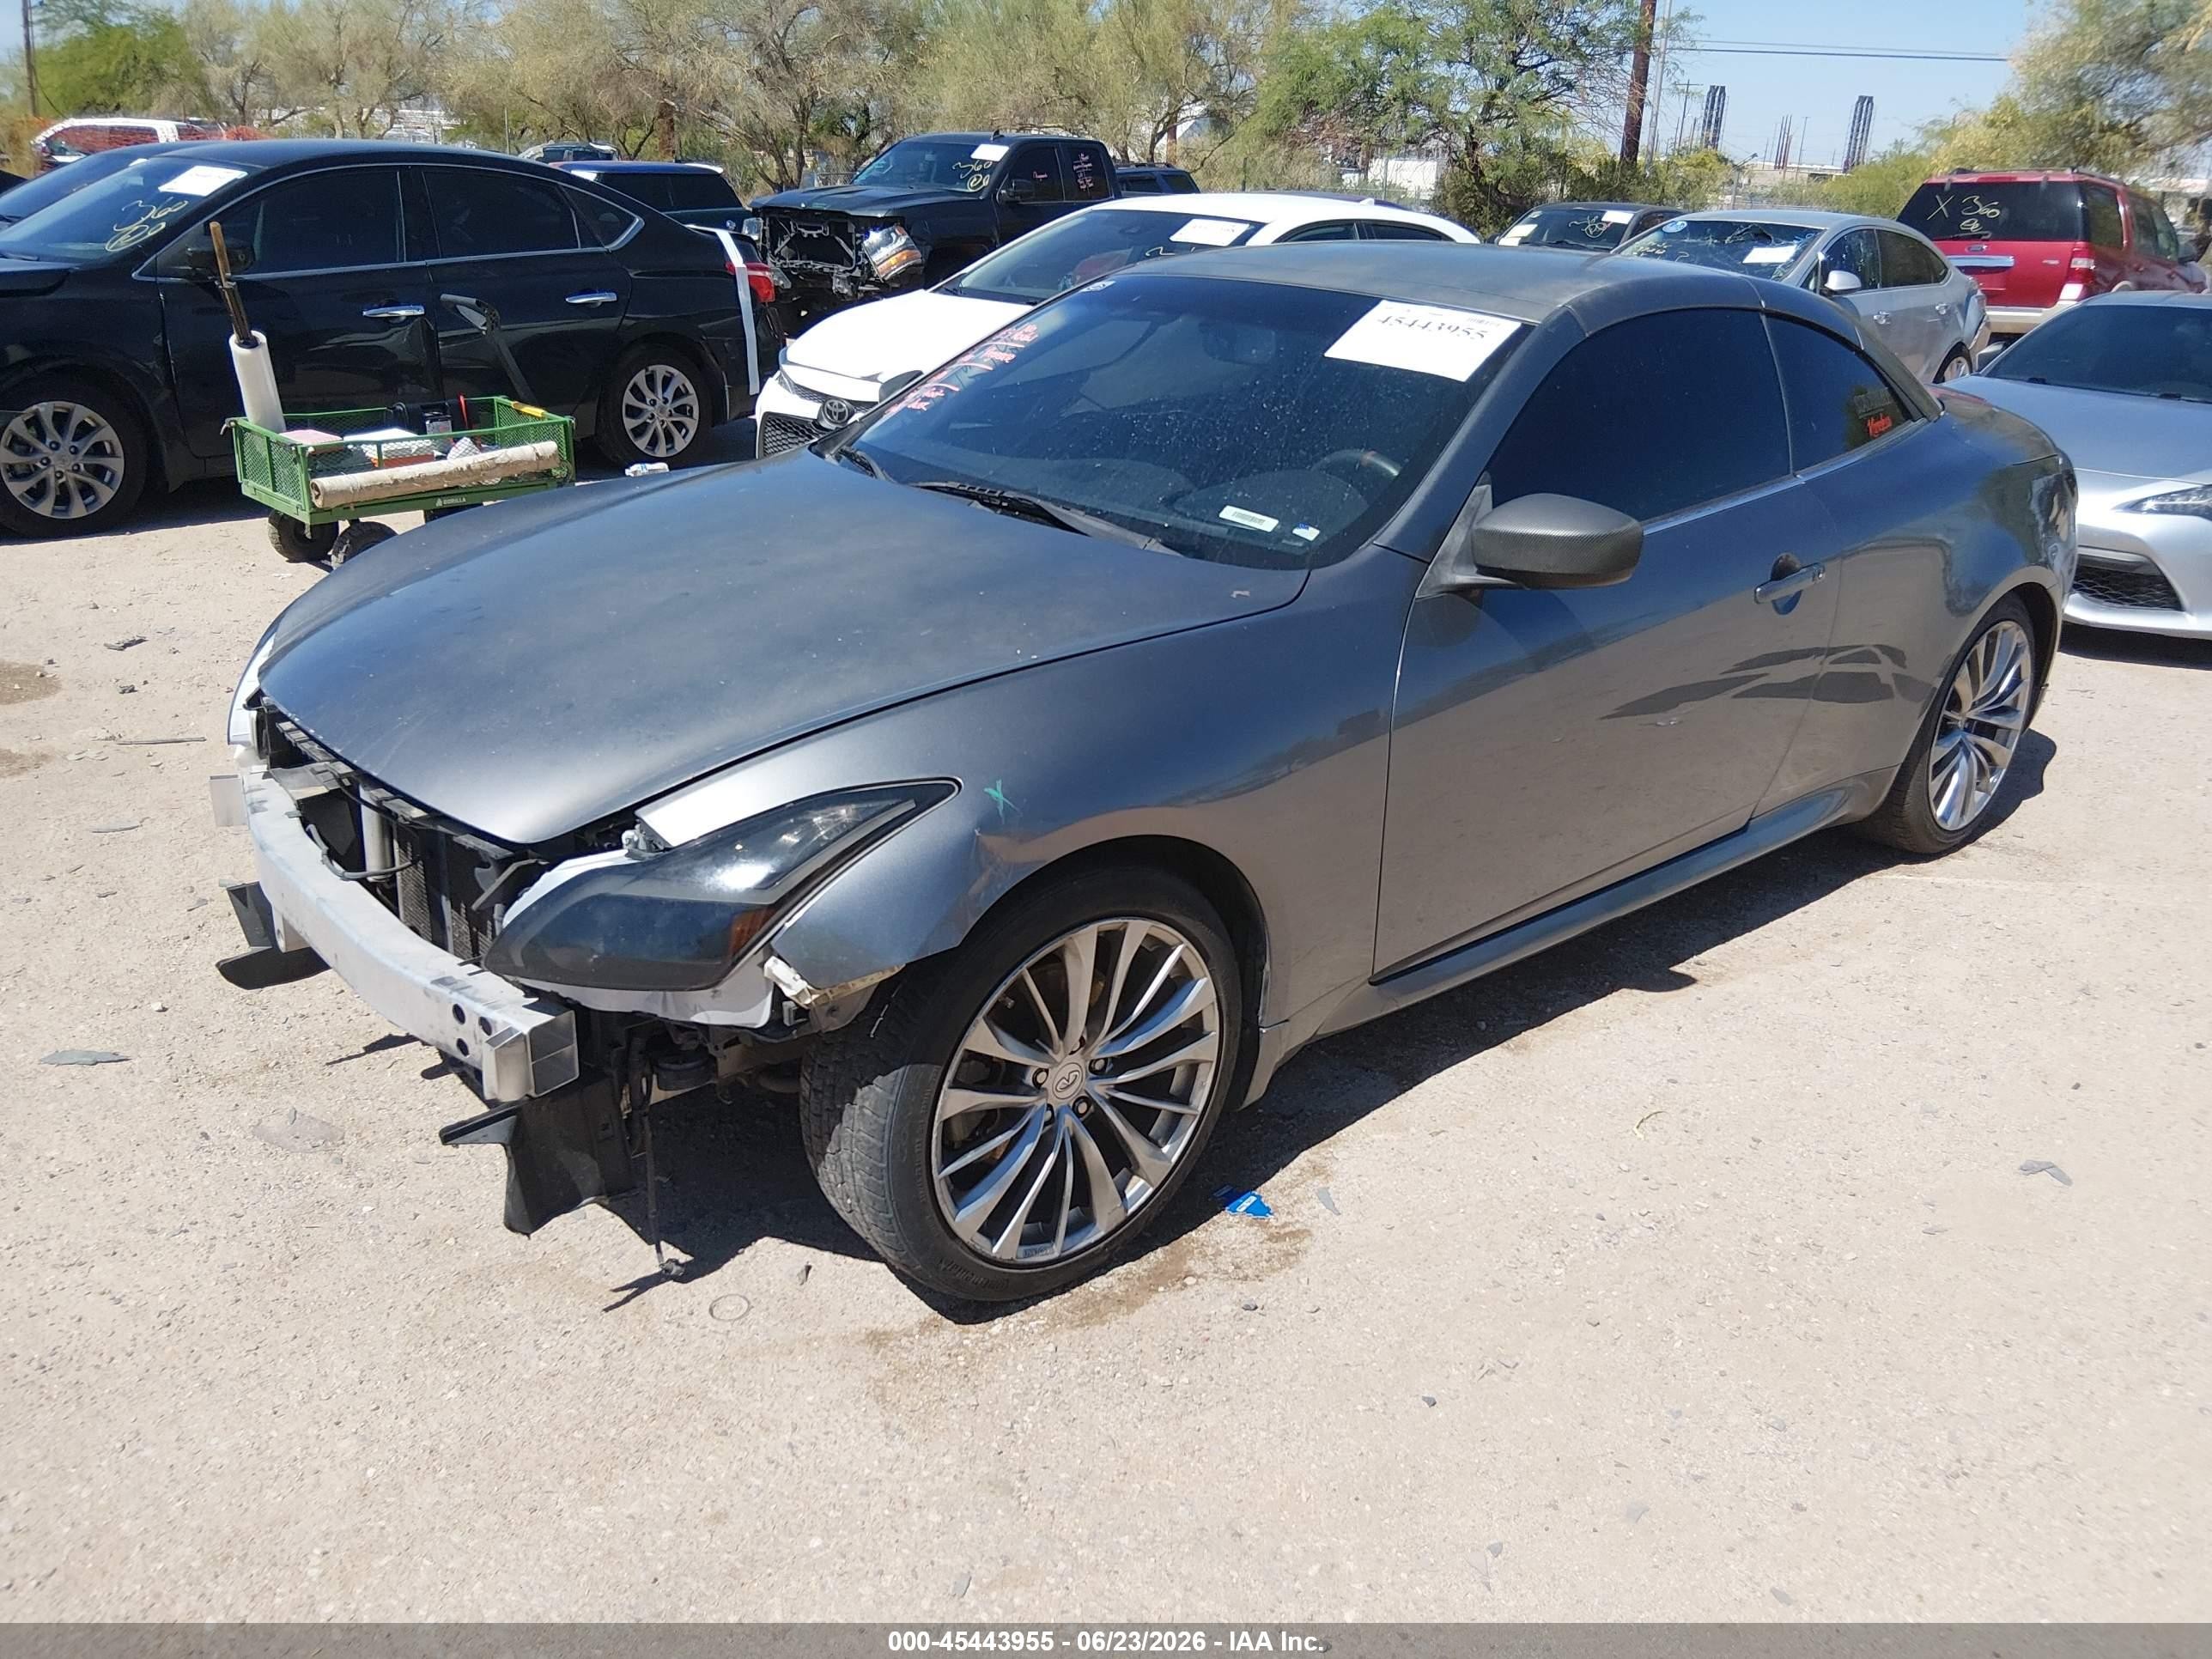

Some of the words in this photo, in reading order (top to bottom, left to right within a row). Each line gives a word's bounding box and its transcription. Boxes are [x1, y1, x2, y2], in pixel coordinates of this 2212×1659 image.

[952, 160, 993, 179] 360
[113, 197, 189, 231] 360
[1960, 195, 2000, 218] 360
